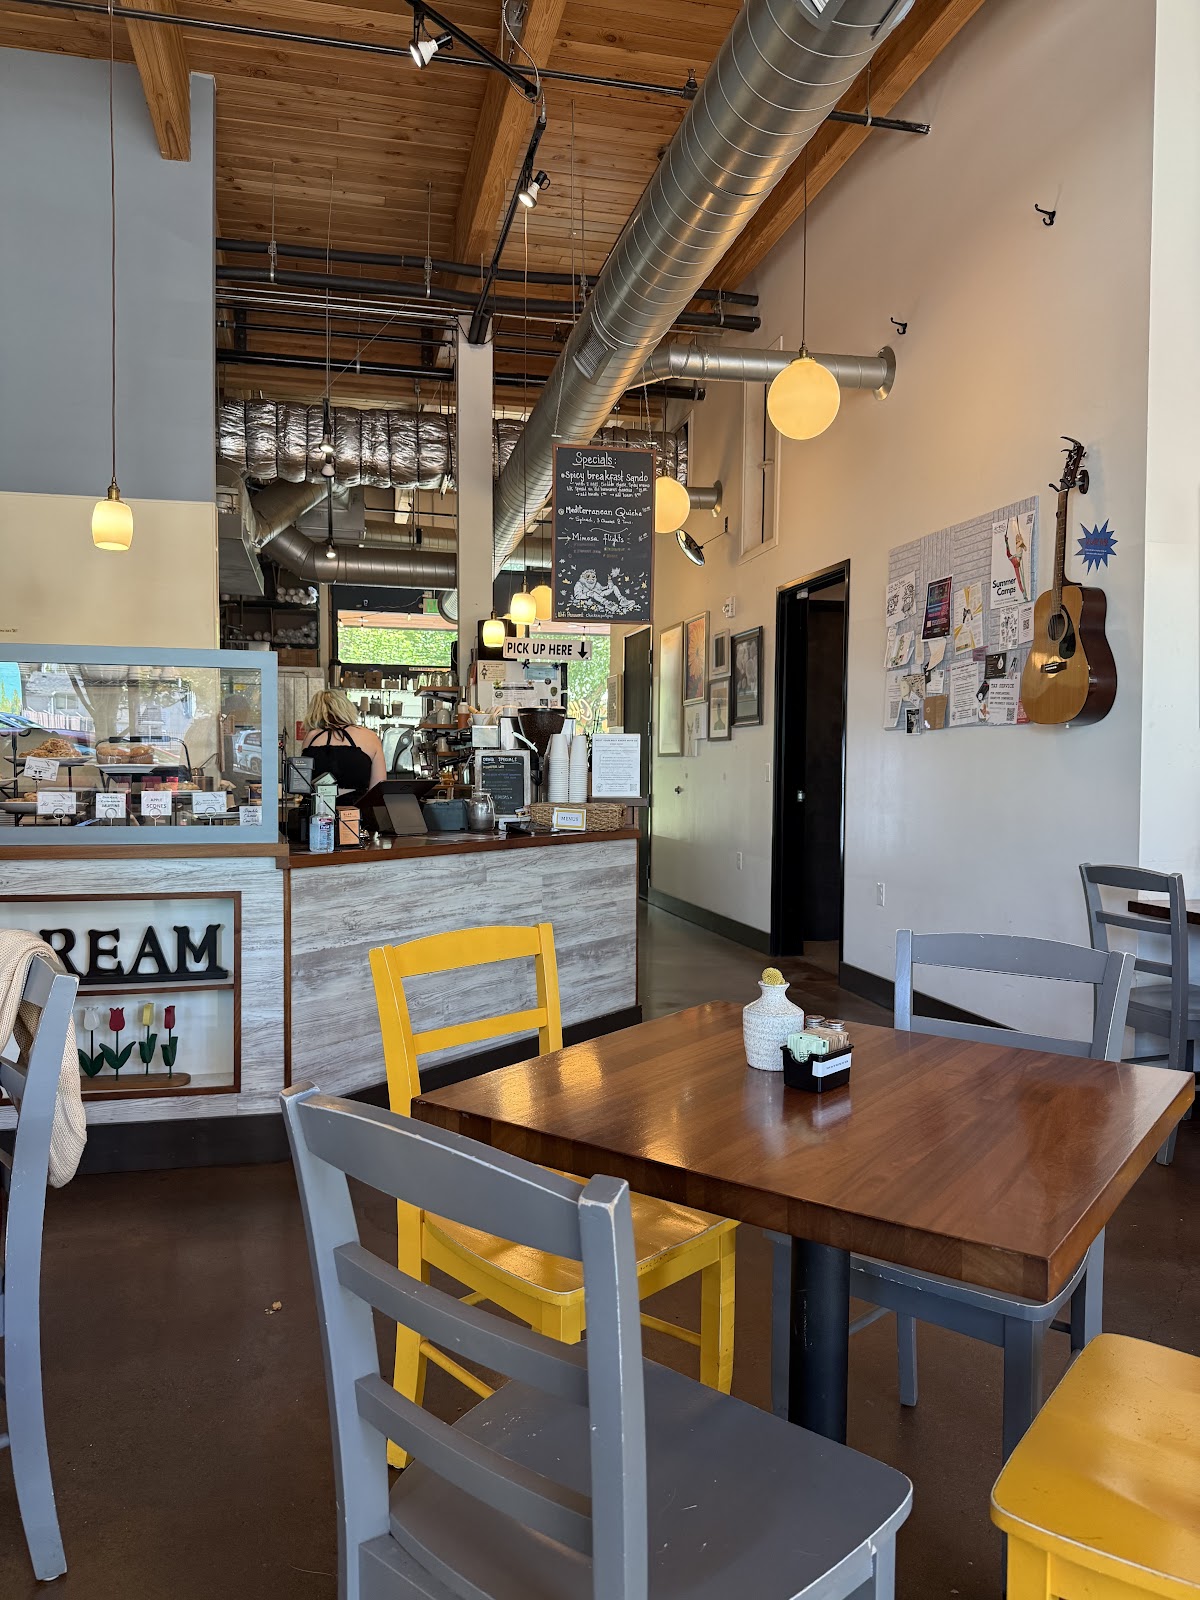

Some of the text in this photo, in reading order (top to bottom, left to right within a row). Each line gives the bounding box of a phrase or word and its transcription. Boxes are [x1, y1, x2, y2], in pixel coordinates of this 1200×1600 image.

[575, 451, 617, 469] Specials:
[565, 469, 649, 483] Spicy breakfast Sando
[565, 505, 613, 516] Mediterranean
[615, 507, 643, 519] Quiche
[572, 532, 600, 541] Mimosa
[992, 577, 1016, 588] Summer
[996, 586, 1016, 596] Camps
[507, 642, 573, 656] PICK UP HERE
[39, 923, 222, 978] REAM
